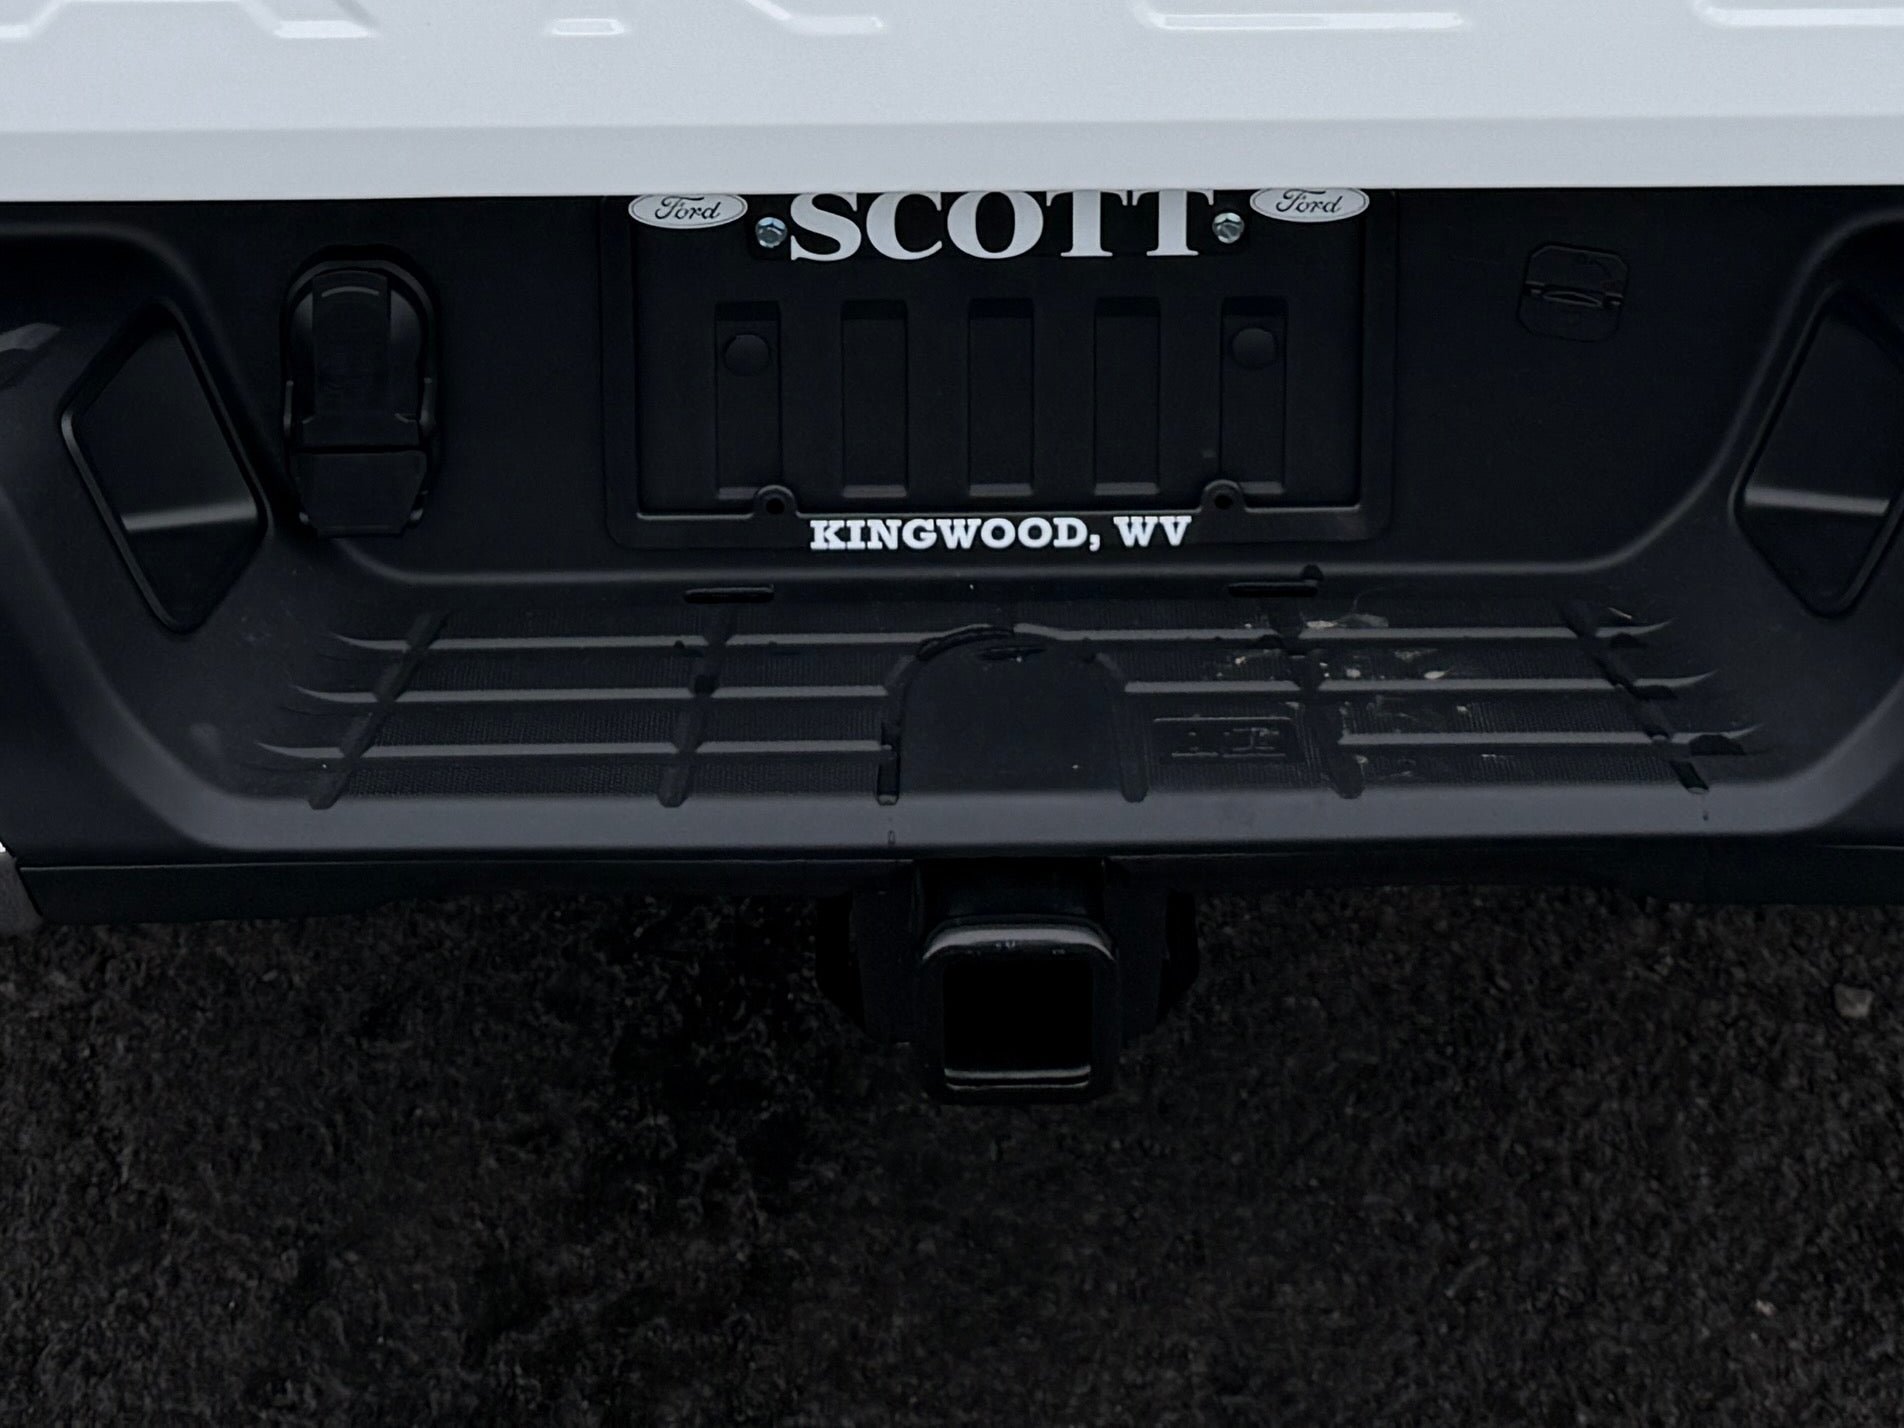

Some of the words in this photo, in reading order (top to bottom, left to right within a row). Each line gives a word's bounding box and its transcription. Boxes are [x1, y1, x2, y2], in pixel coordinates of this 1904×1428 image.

[654, 195, 722, 220] Ford
[1275, 188, 1344, 214] Ford
[789, 189, 1215, 261] SCOTT
[809, 516, 1101, 552] KINGWOOD,
[1113, 515, 1193, 547] WV
